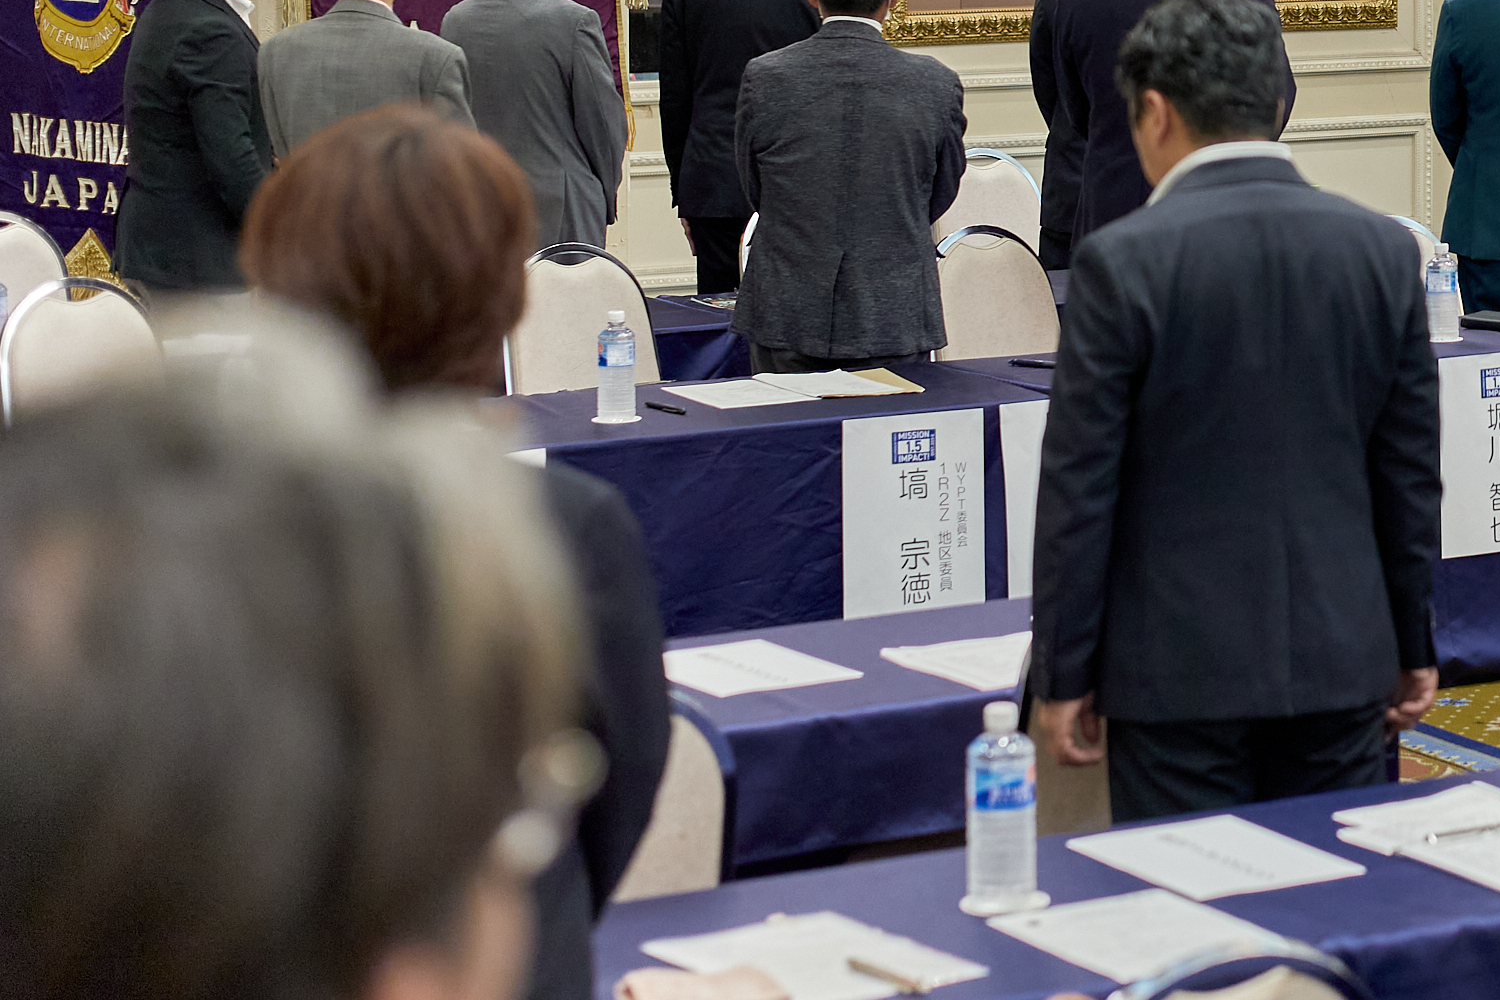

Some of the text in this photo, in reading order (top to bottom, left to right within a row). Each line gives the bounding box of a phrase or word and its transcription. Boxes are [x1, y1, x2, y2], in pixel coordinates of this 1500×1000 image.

[898, 430, 930, 440] MISSION
[906, 440, 922, 453] 1.5
[898, 452, 930, 462] IMPACT!
[955, 462, 968, 548] WYPT委員会
